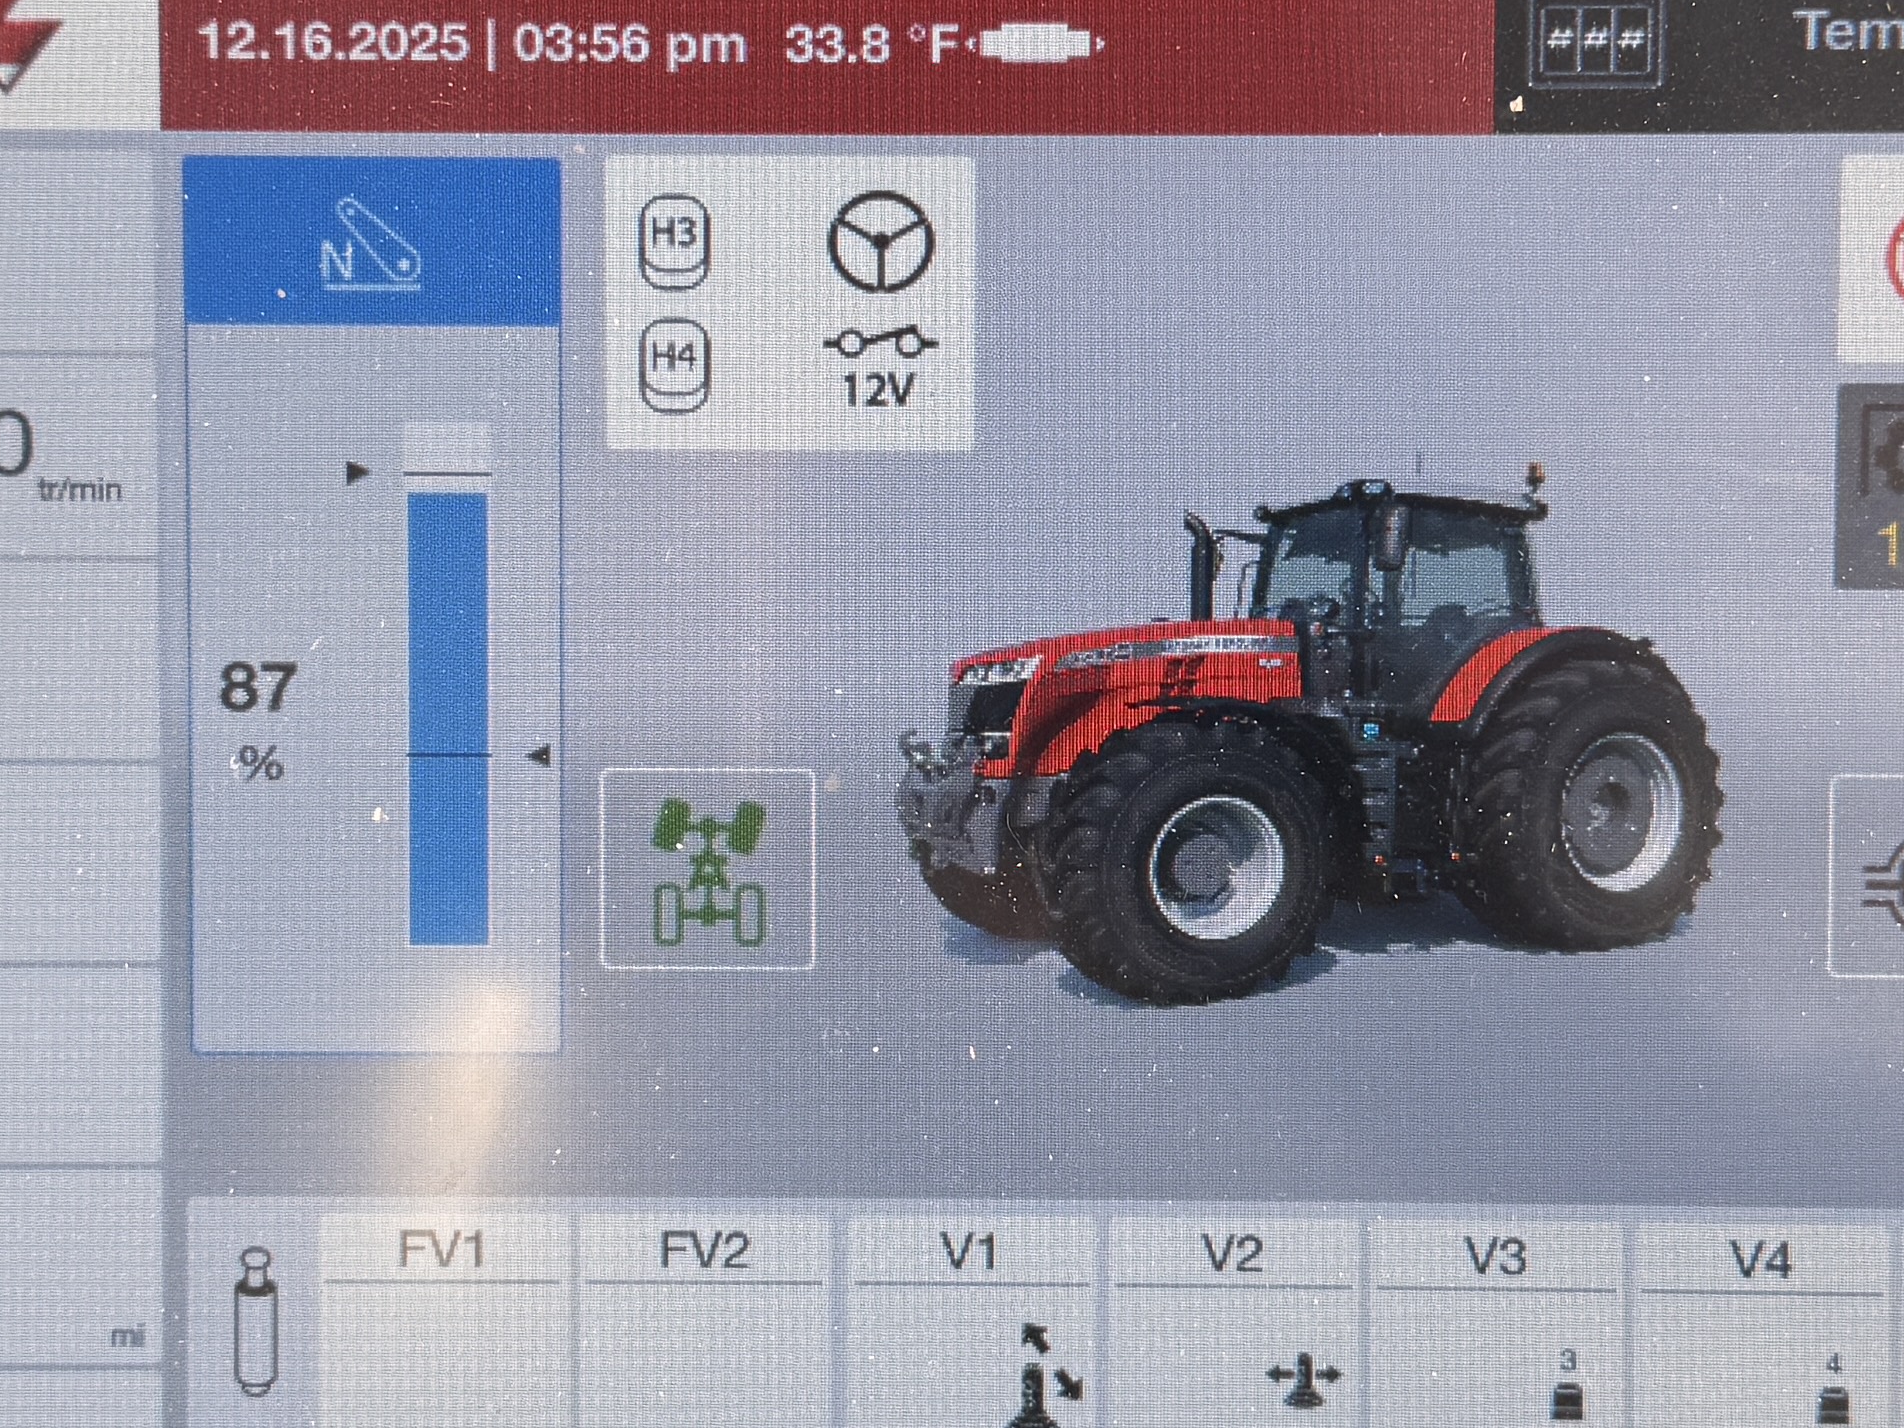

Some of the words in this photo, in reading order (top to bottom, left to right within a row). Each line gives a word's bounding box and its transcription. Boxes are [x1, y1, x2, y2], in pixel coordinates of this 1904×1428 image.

[197, 19, 470, 62] 12.16.2025
[513, 21, 650, 63] 03:56
[666, 30, 748, 73] pm
[785, 23, 891, 64] 33.8
[907, 23, 960, 64] °F
[652, 215, 696, 250] H3
[320, 242, 350, 280] N
[652, 340, 696, 374] H4
[843, 375, 915, 409] 12V
[38, 477, 122, 503] tr/min
[220, 660, 297, 713] 87
[238, 744, 285, 782] %
[398, 1231, 484, 1269] FV1
[660, 1232, 749, 1270] FV2
[941, 1233, 998, 1271] V1
[1201, 1235, 1263, 1273] V2
[1464, 1238, 1528, 1277] V3
[1730, 1241, 1793, 1279] V4
[110, 1324, 147, 1348] mi
[1560, 1350, 1576, 1371] 3
[1825, 1353, 1842, 1374] 4
